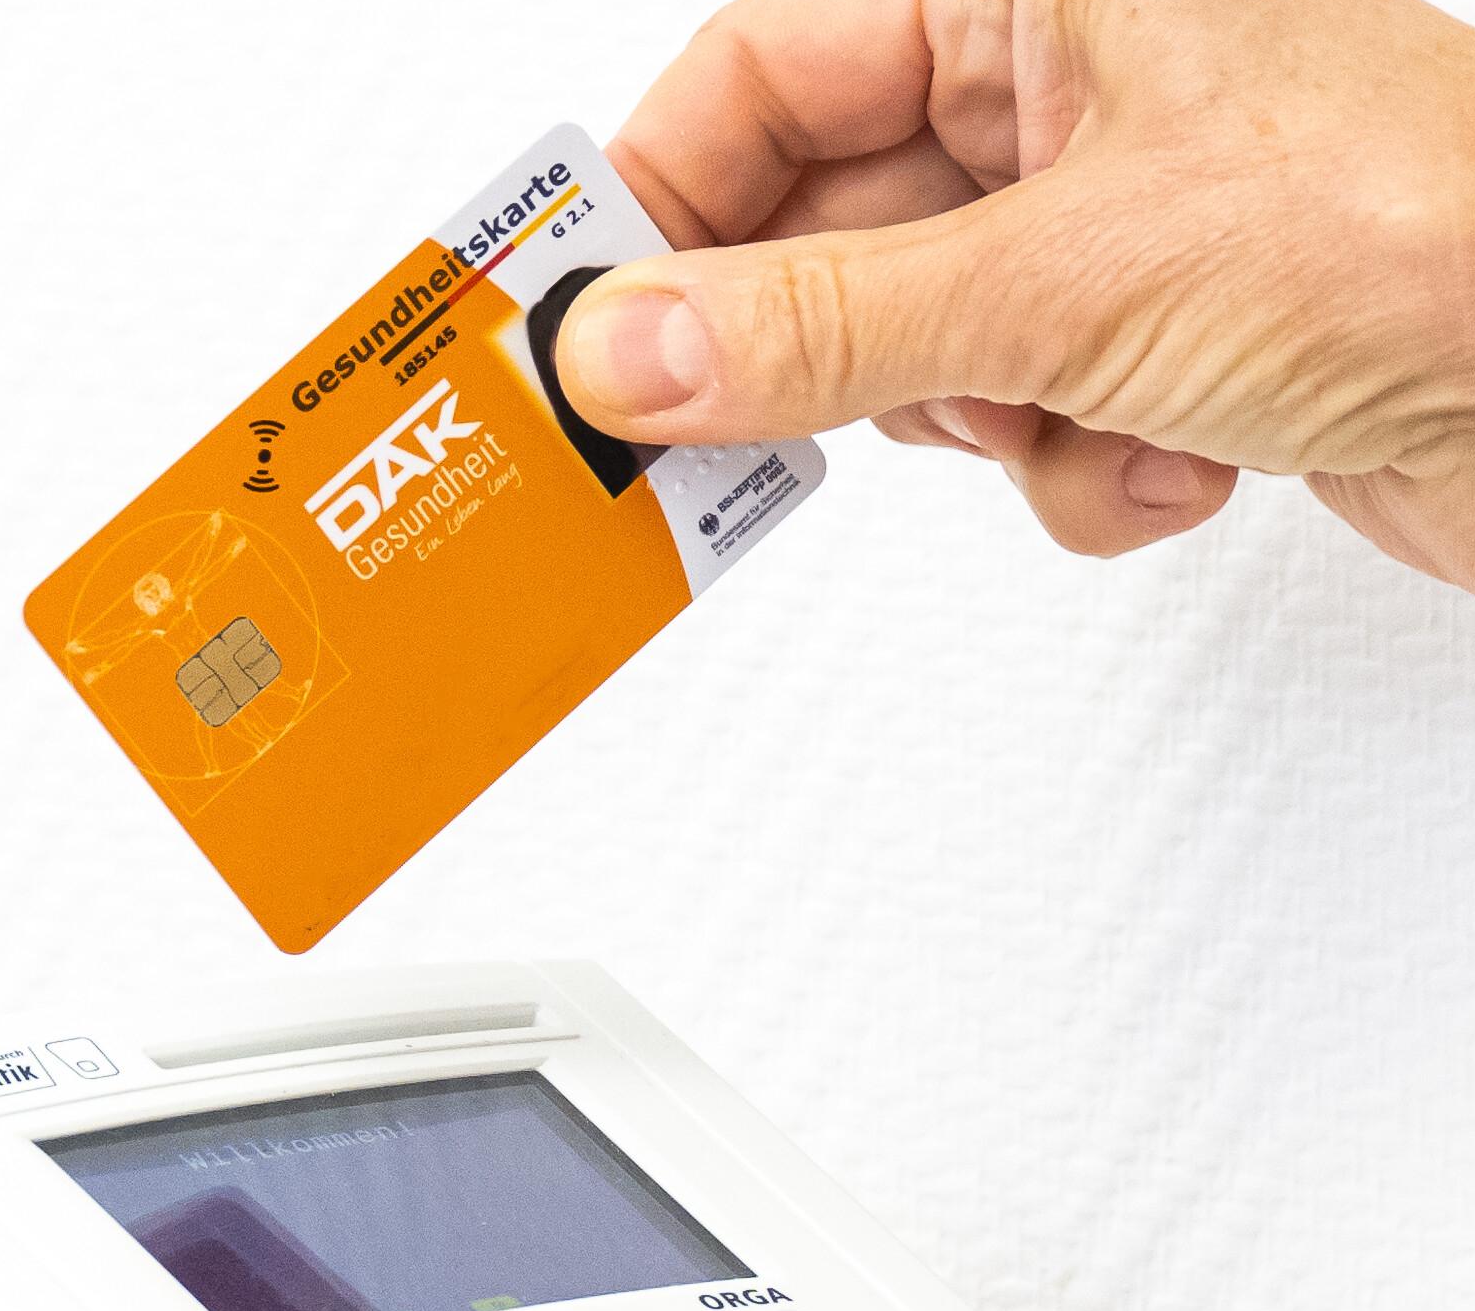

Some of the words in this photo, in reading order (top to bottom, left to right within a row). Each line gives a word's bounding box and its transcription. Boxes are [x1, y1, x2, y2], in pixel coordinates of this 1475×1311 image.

[551, 222, 566, 240] G
[566, 197, 596, 227] 2.1
[291, 162, 572, 412] Gesundheitskarte
[394, 325, 458, 387] 185145
[304, 377, 484, 552] DAK
[716, 451, 781, 514] BSI-ZERTIFIKAT
[752, 480, 766, 496] PP
[345, 432, 508, 580] Gesundheit
[414, 536, 444, 562] Ein
[445, 497, 486, 536] Leben
[710, 512, 750, 552] Bundesamt
[715, 547, 724, 558] in
[725, 538, 737, 551] der
[178, 1120, 413, 1172] Willkommen!
[698, 1287, 794, 1311] ORGA
